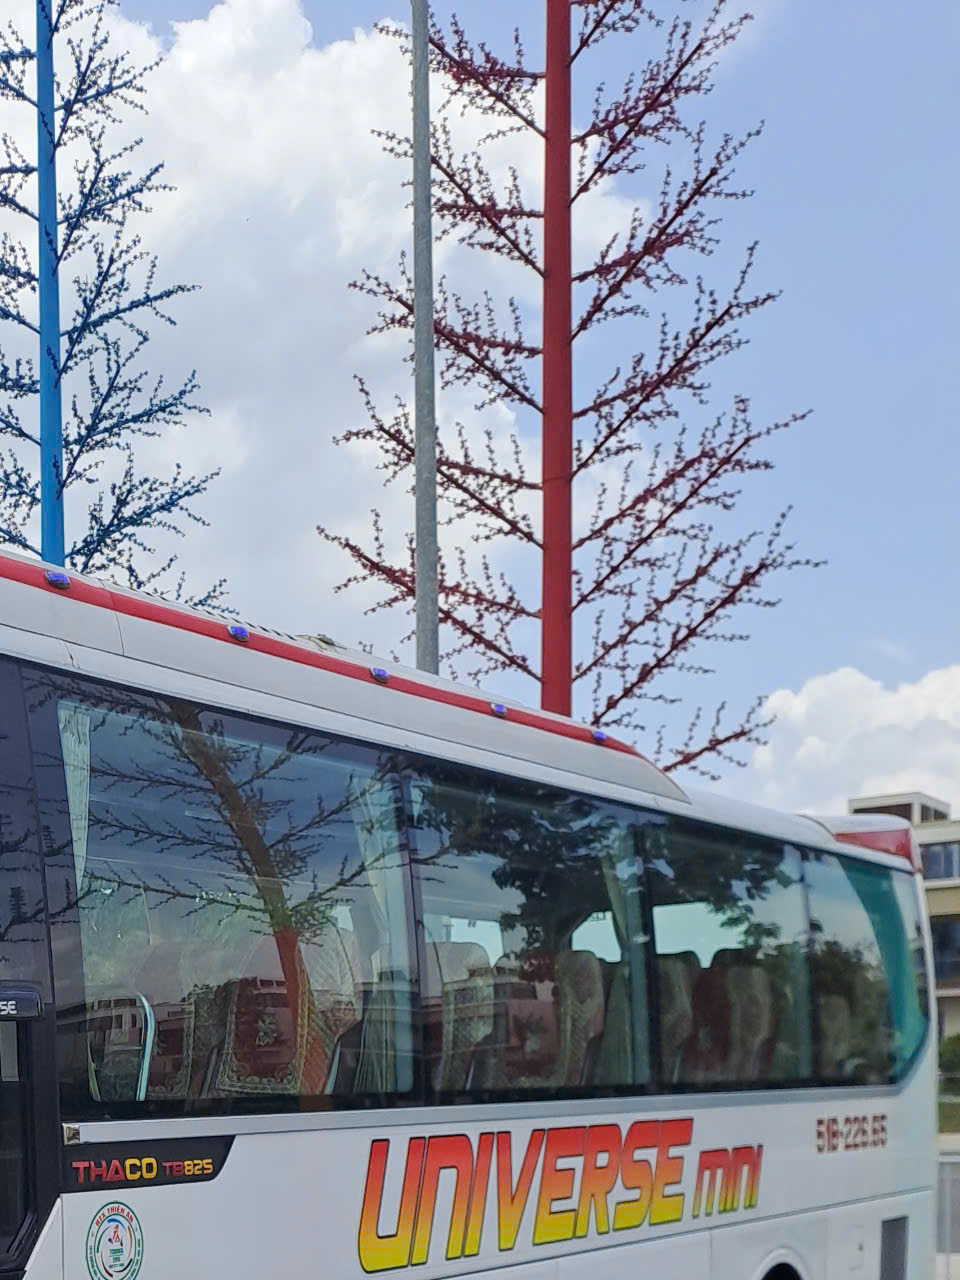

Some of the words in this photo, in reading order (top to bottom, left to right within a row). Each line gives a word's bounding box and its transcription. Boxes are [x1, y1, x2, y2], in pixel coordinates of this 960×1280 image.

[72, 1157, 158, 1184] THACO
[162, 1158, 214, 1177] TB825
[358, 1117, 695, 1274] UNIVERSE
